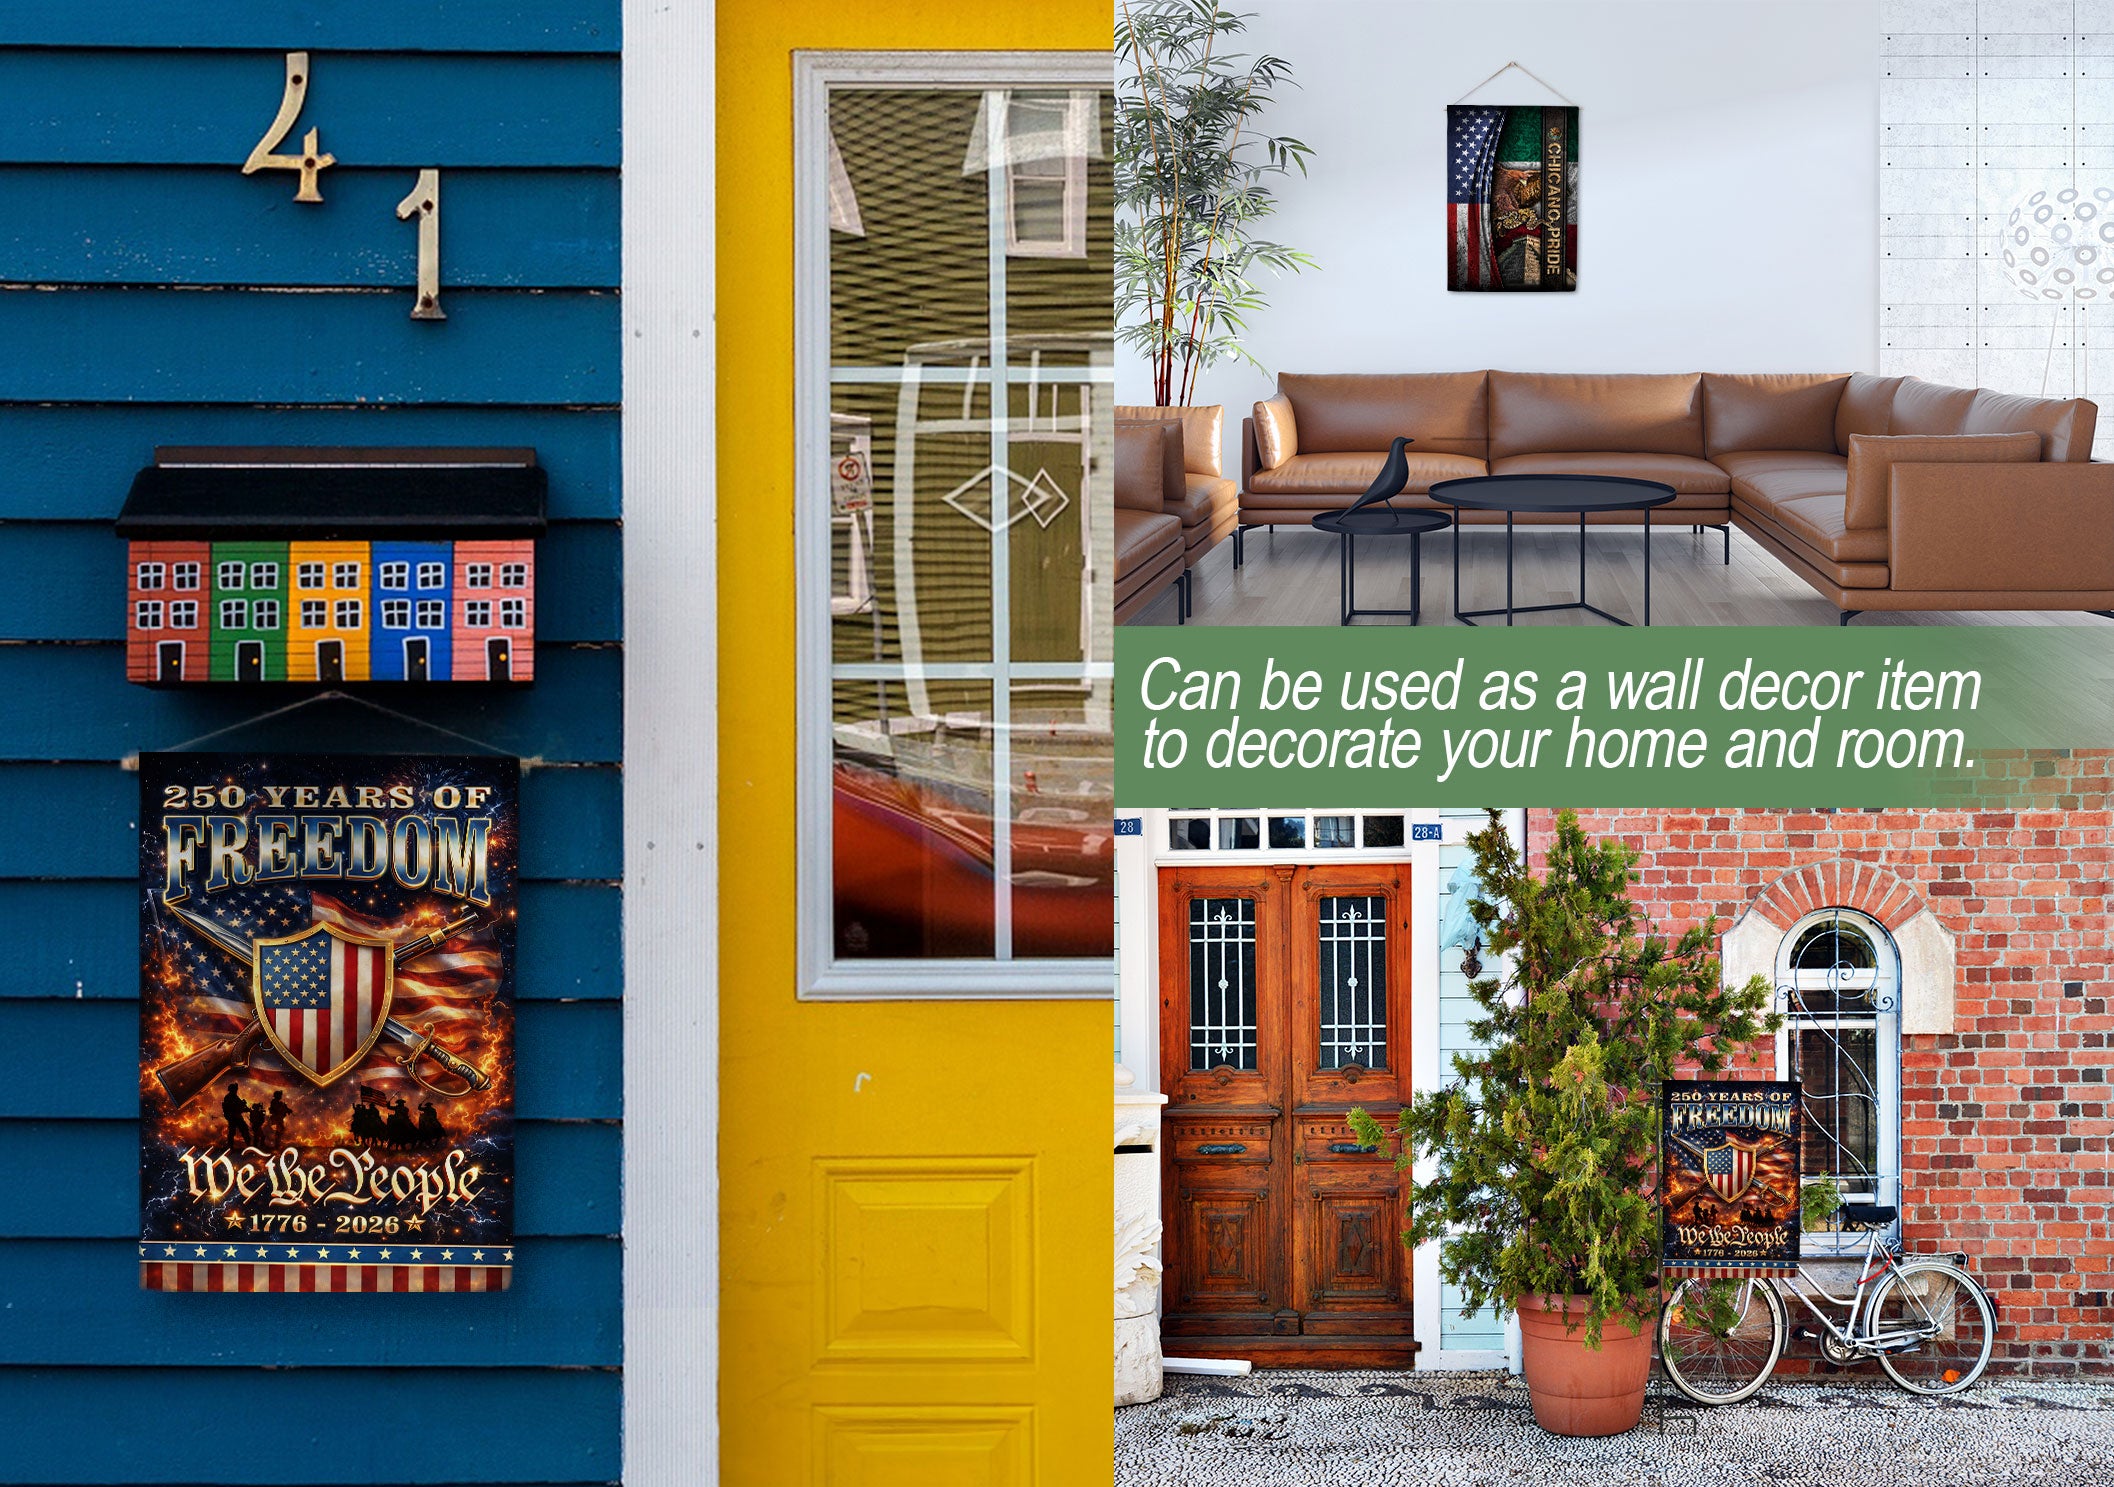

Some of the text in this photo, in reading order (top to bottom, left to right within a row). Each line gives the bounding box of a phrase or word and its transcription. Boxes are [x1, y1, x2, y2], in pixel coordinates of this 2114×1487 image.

[1546, 142, 1561, 275] CHICANO PRIDE
[163, 784, 492, 809] 250 YEARS OF
[1120, 821, 1134, 833] 28
[1414, 826, 1440, 839] 28-A
[162, 814, 492, 905] FREEDOM
[1671, 1092, 1792, 1102] 250 YEARS OF
[1670, 1103, 1792, 1136] FREEDOM
[178, 1146, 487, 1213] We the People
[250, 1214, 307, 1234] 1776
[335, 1214, 400, 1234] 2026
[1676, 1224, 1789, 1249] We the People
